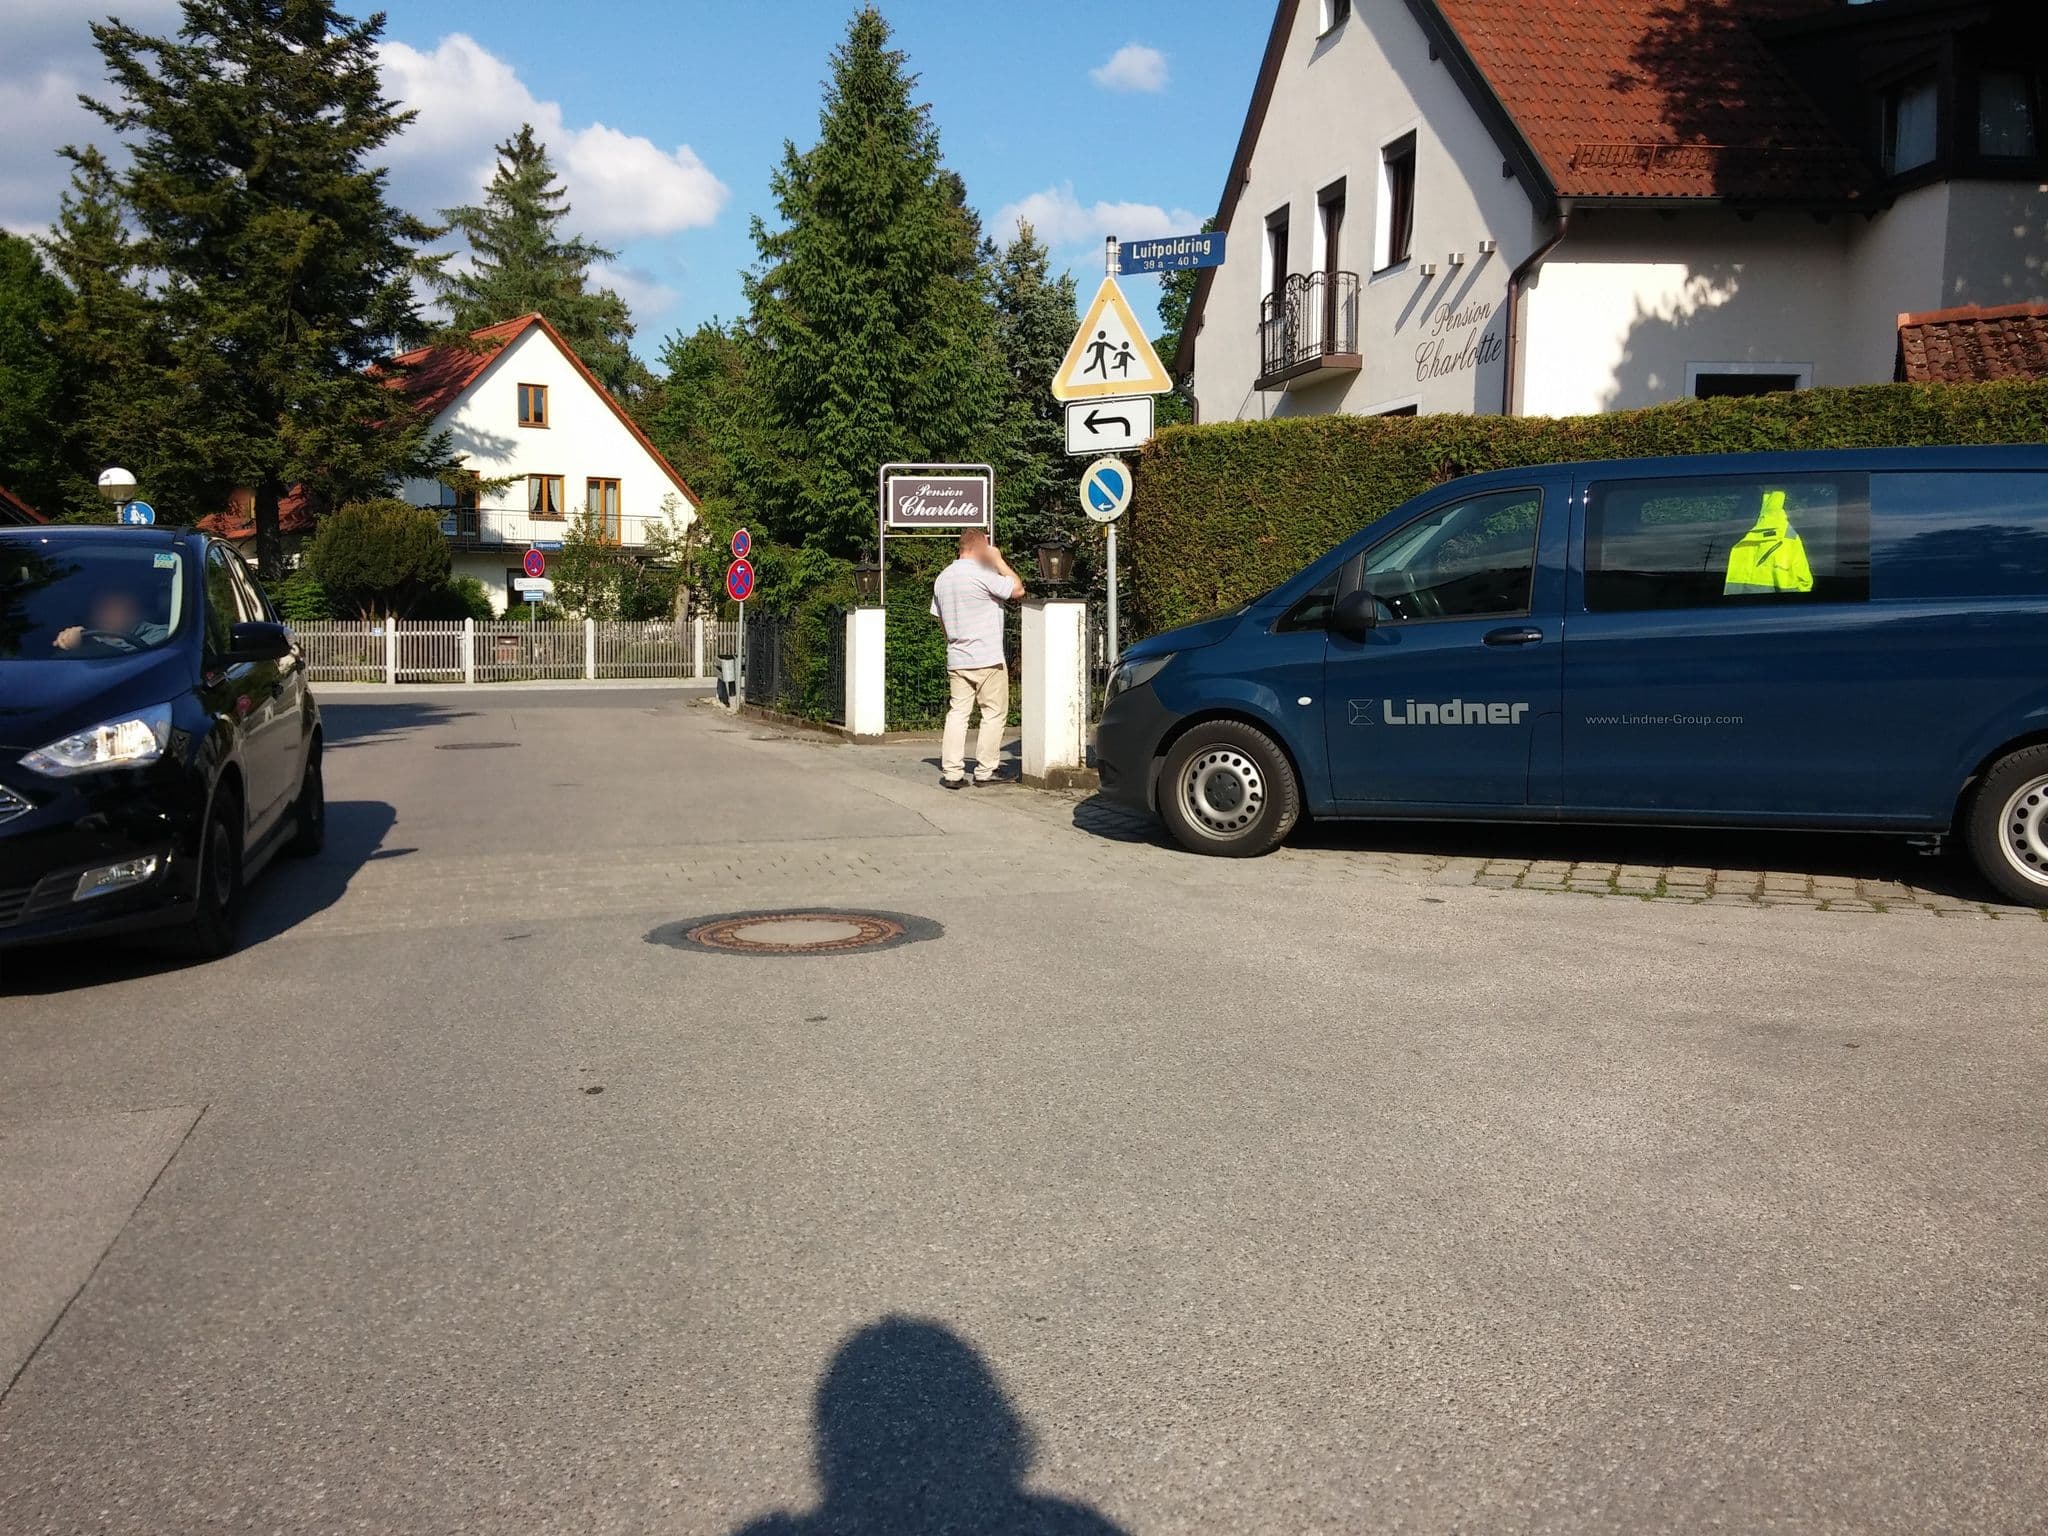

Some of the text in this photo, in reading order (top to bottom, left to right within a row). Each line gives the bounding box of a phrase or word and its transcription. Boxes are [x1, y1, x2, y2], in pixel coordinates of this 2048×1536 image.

[1132, 238, 1211, 259] Luitpoldring
[1157, 261, 1164, 269] a
[1177, 256, 1189, 266] 40
[1192, 256, 1199, 265] b
[1431, 301, 1491, 337] Pension
[1415, 327, 1502, 382] Charlotte
[915, 483, 964, 497] Pension
[898, 495, 979, 517] Charlotte
[1383, 699, 1529, 725] Lindner
[1585, 714, 1744, 726] www.Lindner-Group.com
